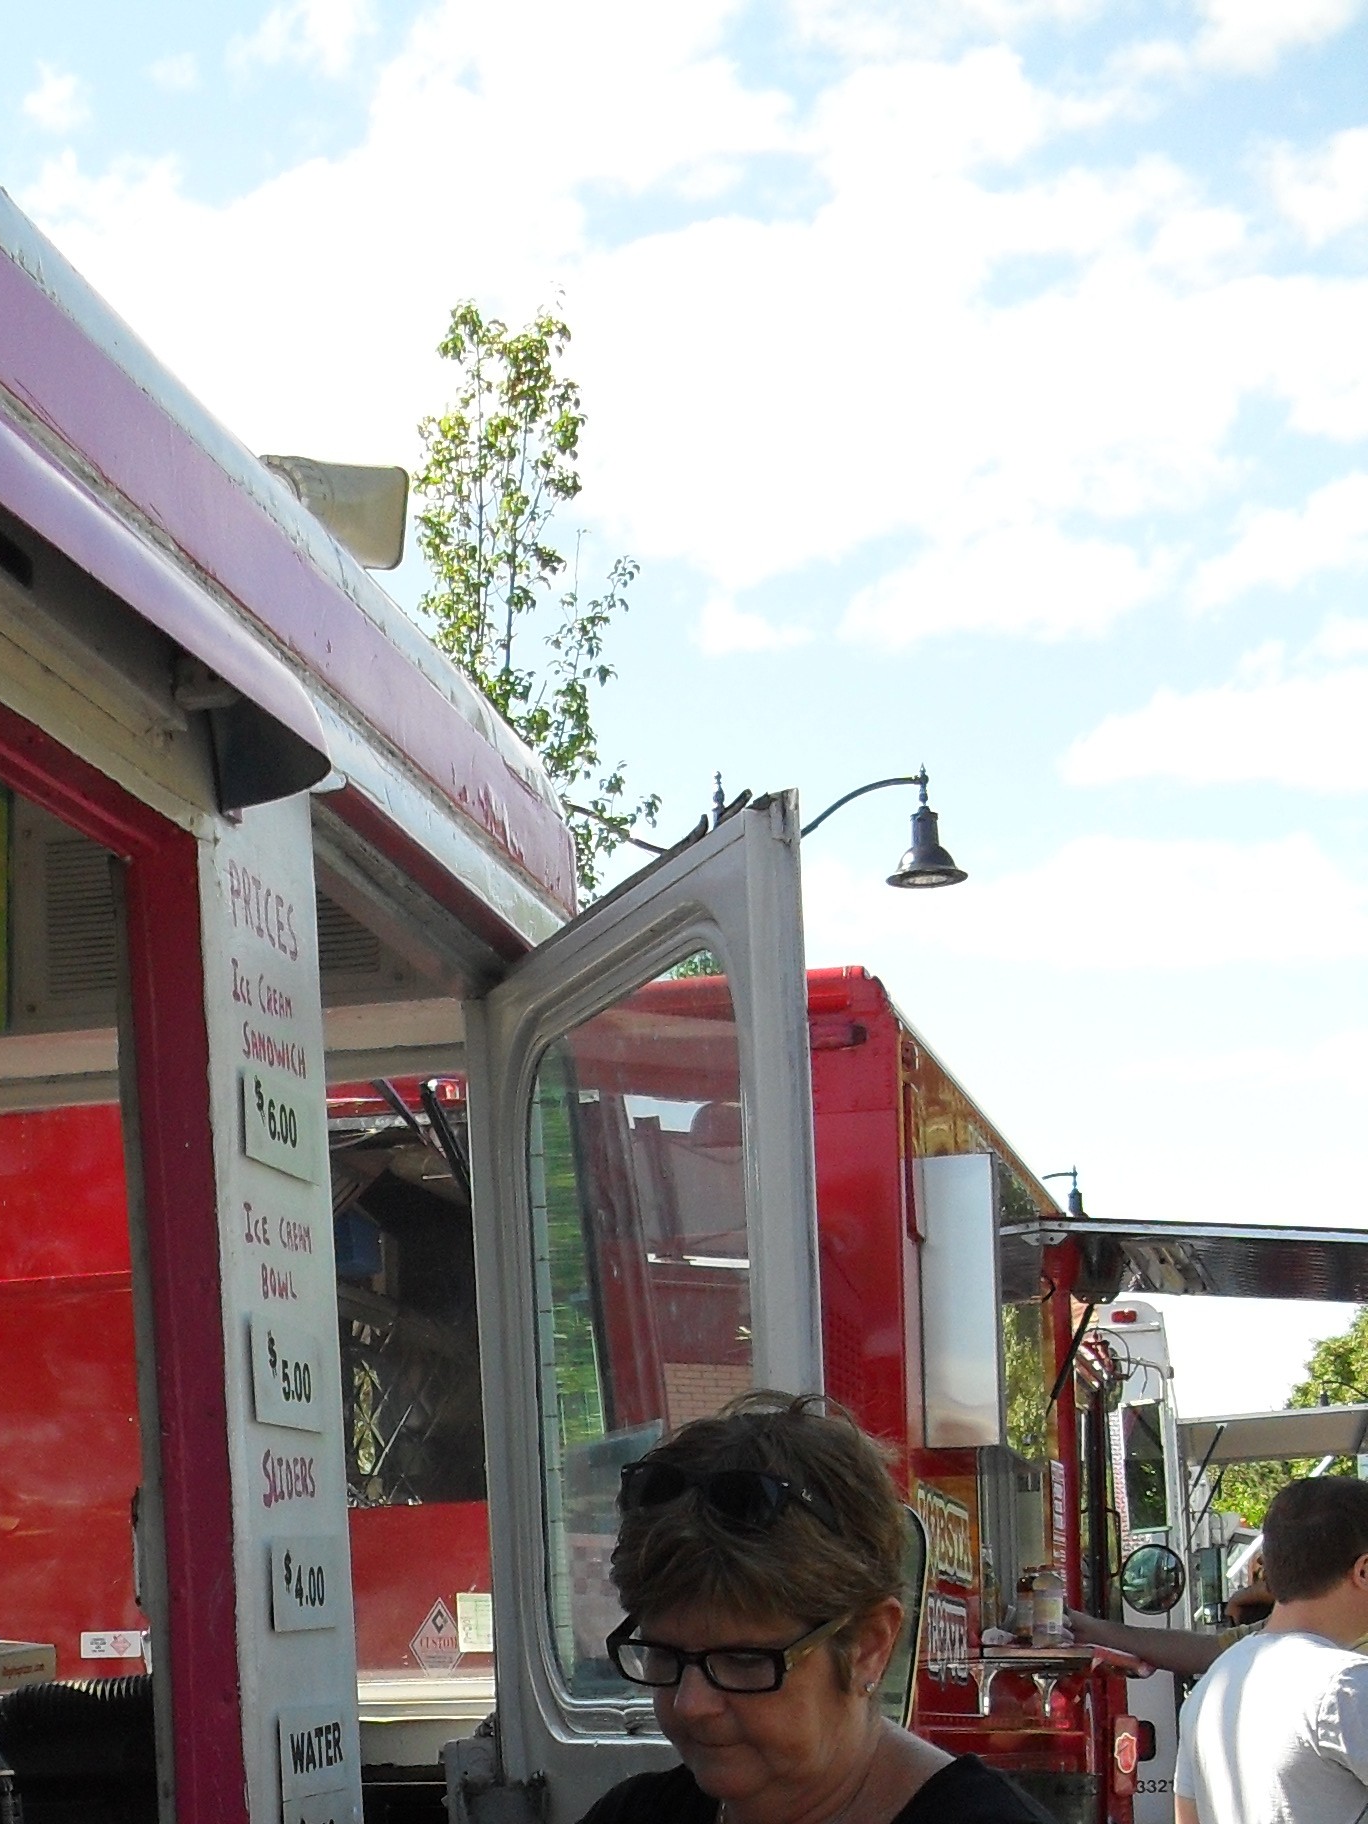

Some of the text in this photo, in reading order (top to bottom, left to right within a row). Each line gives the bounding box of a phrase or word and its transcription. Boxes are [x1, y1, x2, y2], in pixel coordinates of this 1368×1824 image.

[228, 859, 298, 961] PRICES
[230, 957, 293, 1019] ICE CREAM
[242, 1020, 307, 1080] SANDWICH
[253, 1075, 298, 1149] $6.00
[243, 1202, 312, 1255] ICE CREAM
[261, 1263, 298, 1300] BOWL
[266, 1329, 312, 1404] $5.00
[262, 1448, 316, 1509] SLIDERS
[284, 1549, 325, 1607] $4.00
[290, 1721, 344, 1774] WATER
